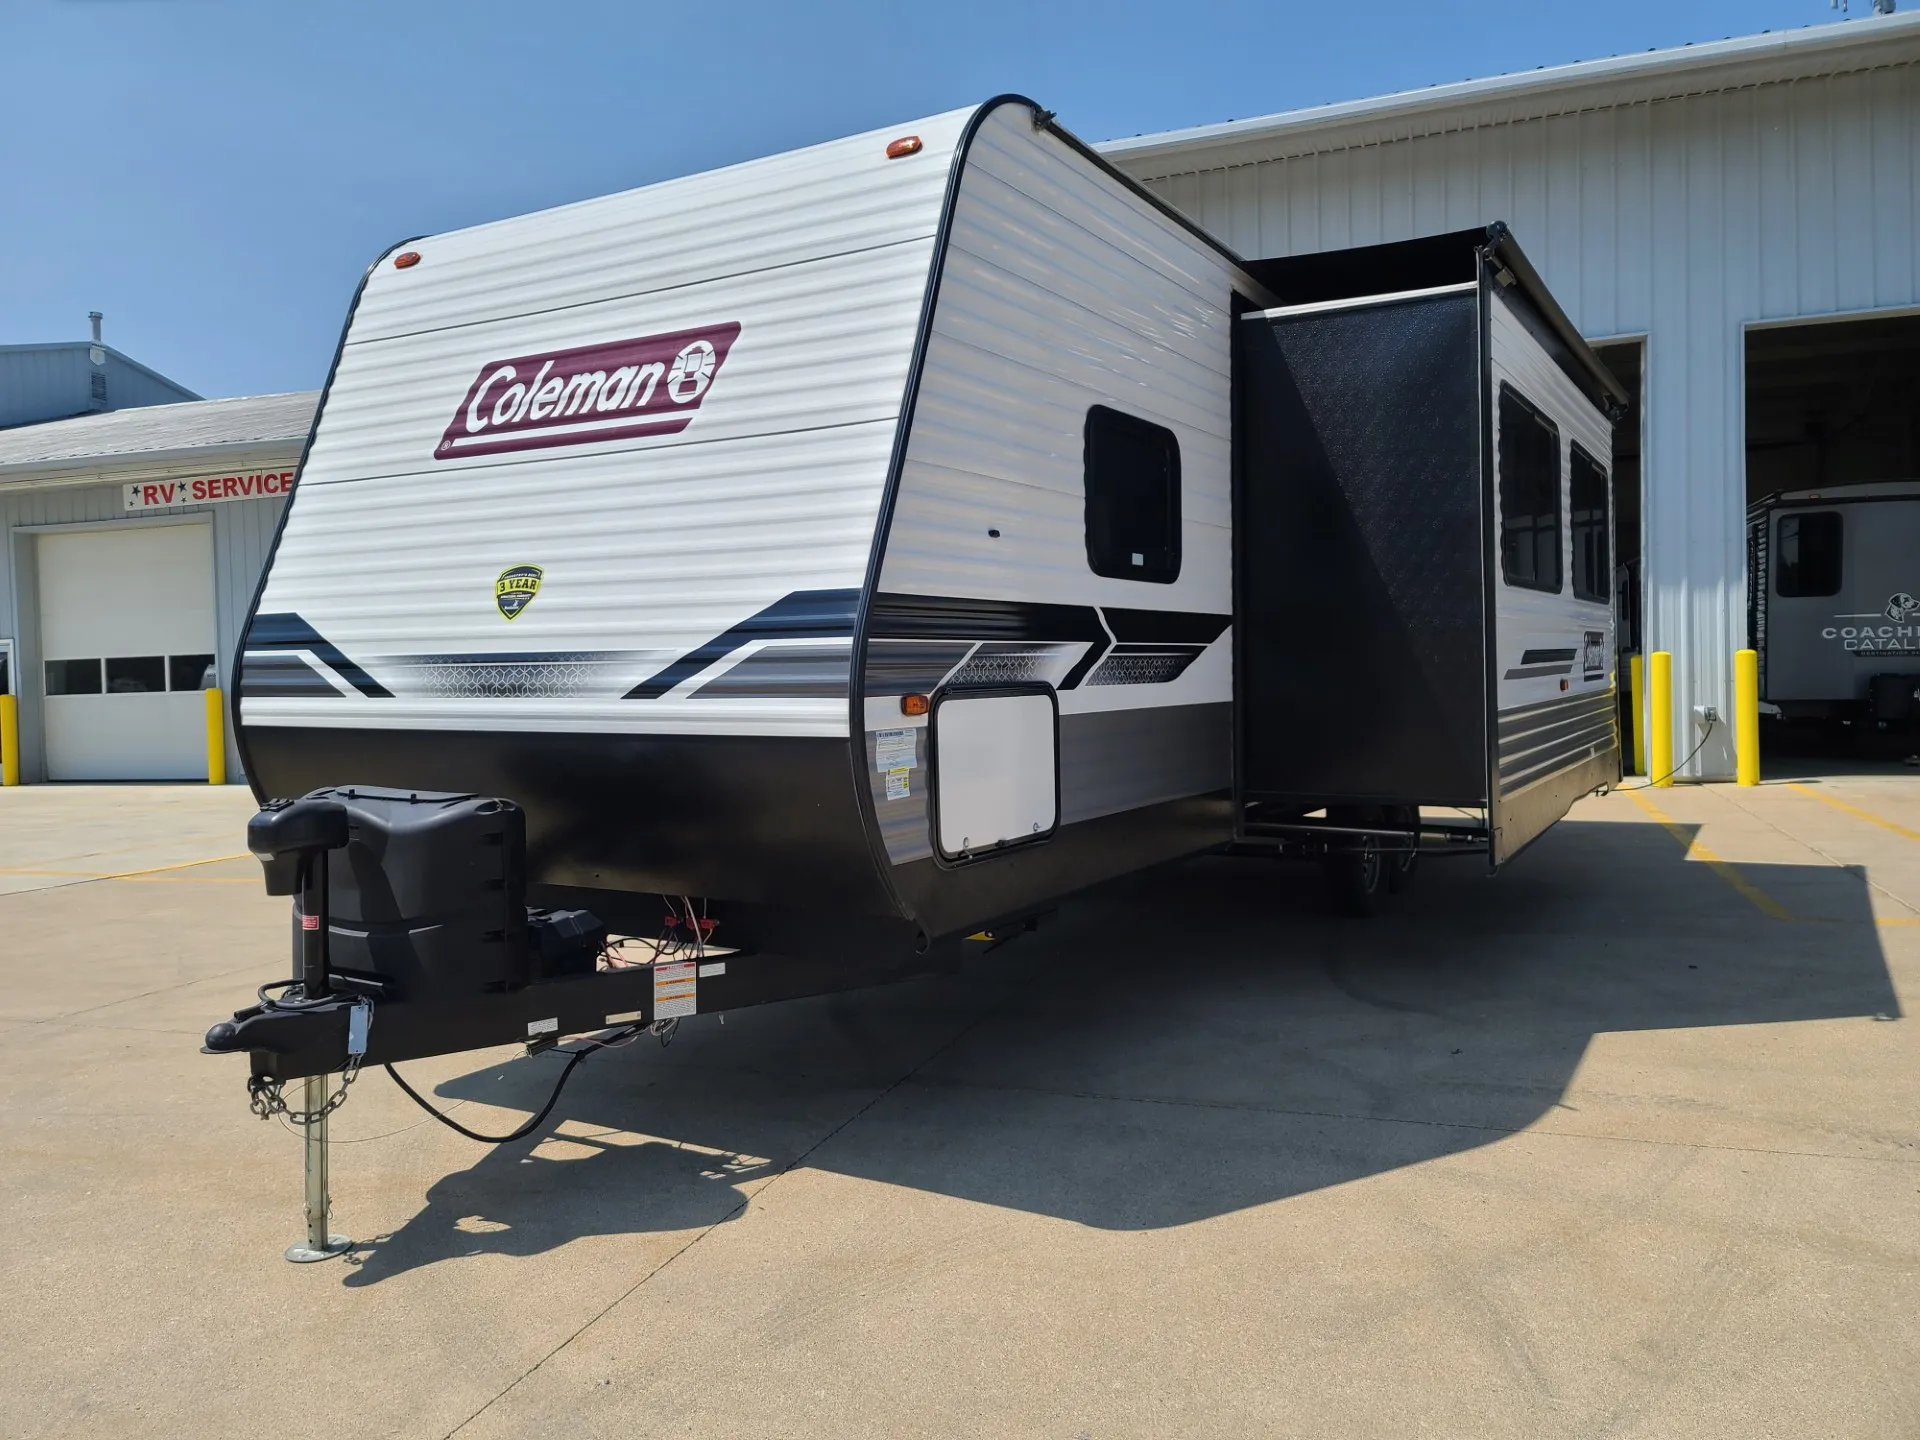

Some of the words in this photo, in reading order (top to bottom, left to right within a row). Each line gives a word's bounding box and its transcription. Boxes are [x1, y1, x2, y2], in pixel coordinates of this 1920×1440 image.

[465, 360, 665, 433] Coleman
[143, 483, 175, 505] RV
[192, 472, 294, 500] SERVICE
[499, 582, 506, 592] 3
[509, 579, 537, 590] YEAR
[1822, 626, 1920, 639] COACH
